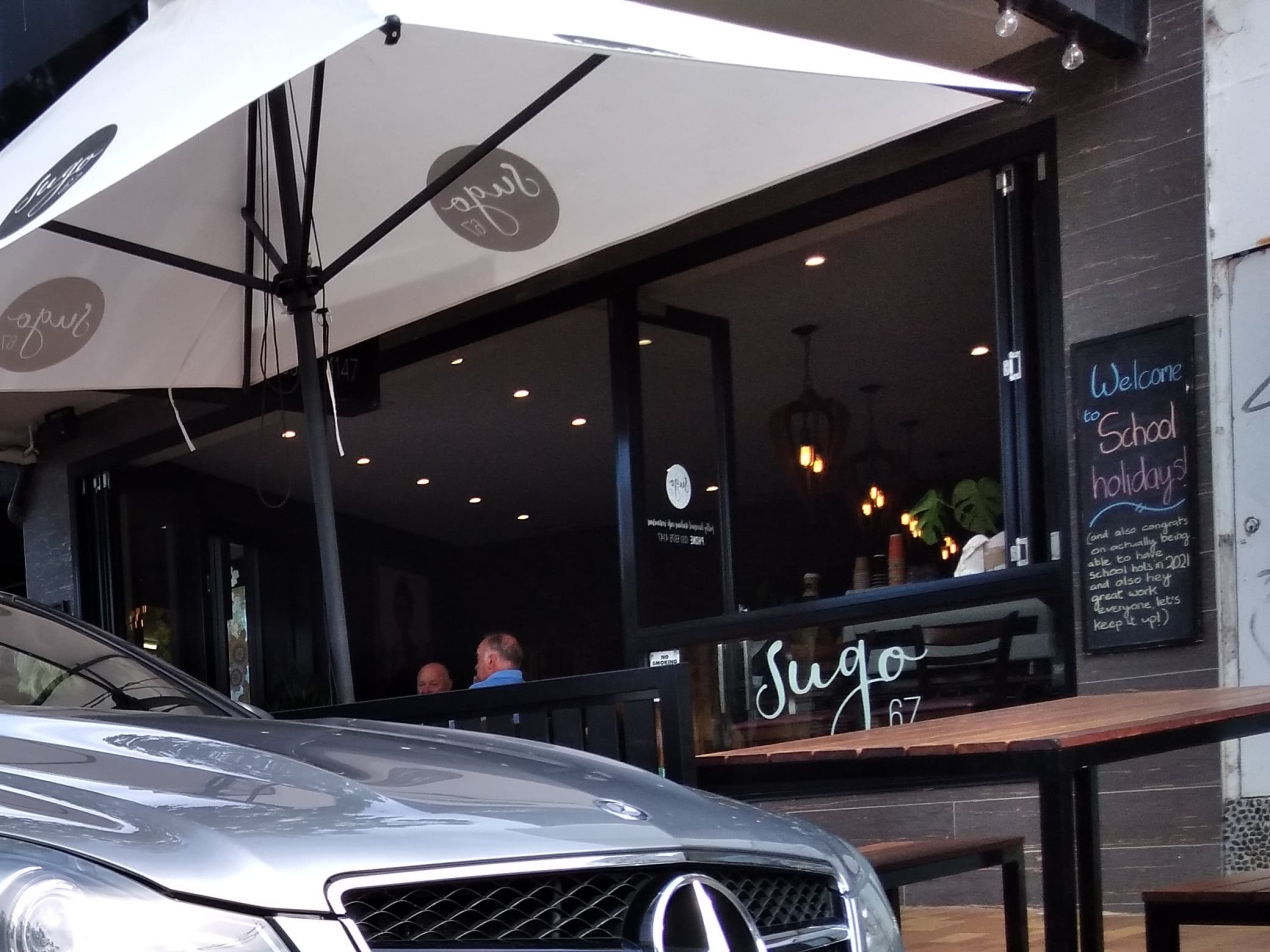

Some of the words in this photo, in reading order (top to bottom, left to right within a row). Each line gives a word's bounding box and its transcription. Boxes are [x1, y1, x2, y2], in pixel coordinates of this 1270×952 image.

[14, 149, 104, 217] Sugo
[1091, 360, 1182, 398] Welcome
[1083, 410, 1100, 422] to
[1098, 401, 1176, 453] School
[1092, 446, 1187, 505] holidays!
[1086, 529, 1109, 545] (and
[1114, 527, 1137, 537] also
[1142, 516, 1189, 534] congrats
[1091, 546, 1106, 555] on
[1110, 536, 1157, 551] actually
[1160, 532, 1189, 546] being
[1088, 557, 1111, 567] able
[1116, 555, 1131, 563] to
[1136, 550, 1163, 560] have
[1155, 560, 1164, 569] in
[1165, 553, 1190, 570] 2021
[1090, 580, 1109, 590] and
[1115, 576, 1141, 587] also
[1146, 572, 1172, 587] hey
[1091, 590, 1123, 611] great
[1128, 585, 1157, 596] work
[1156, 595, 1181, 606] let's
[1126, 617, 1137, 625] it
[1141, 608, 1169, 629] up!)
[756, 640, 928, 735] Sugo
[889, 696, 921, 726] 67
